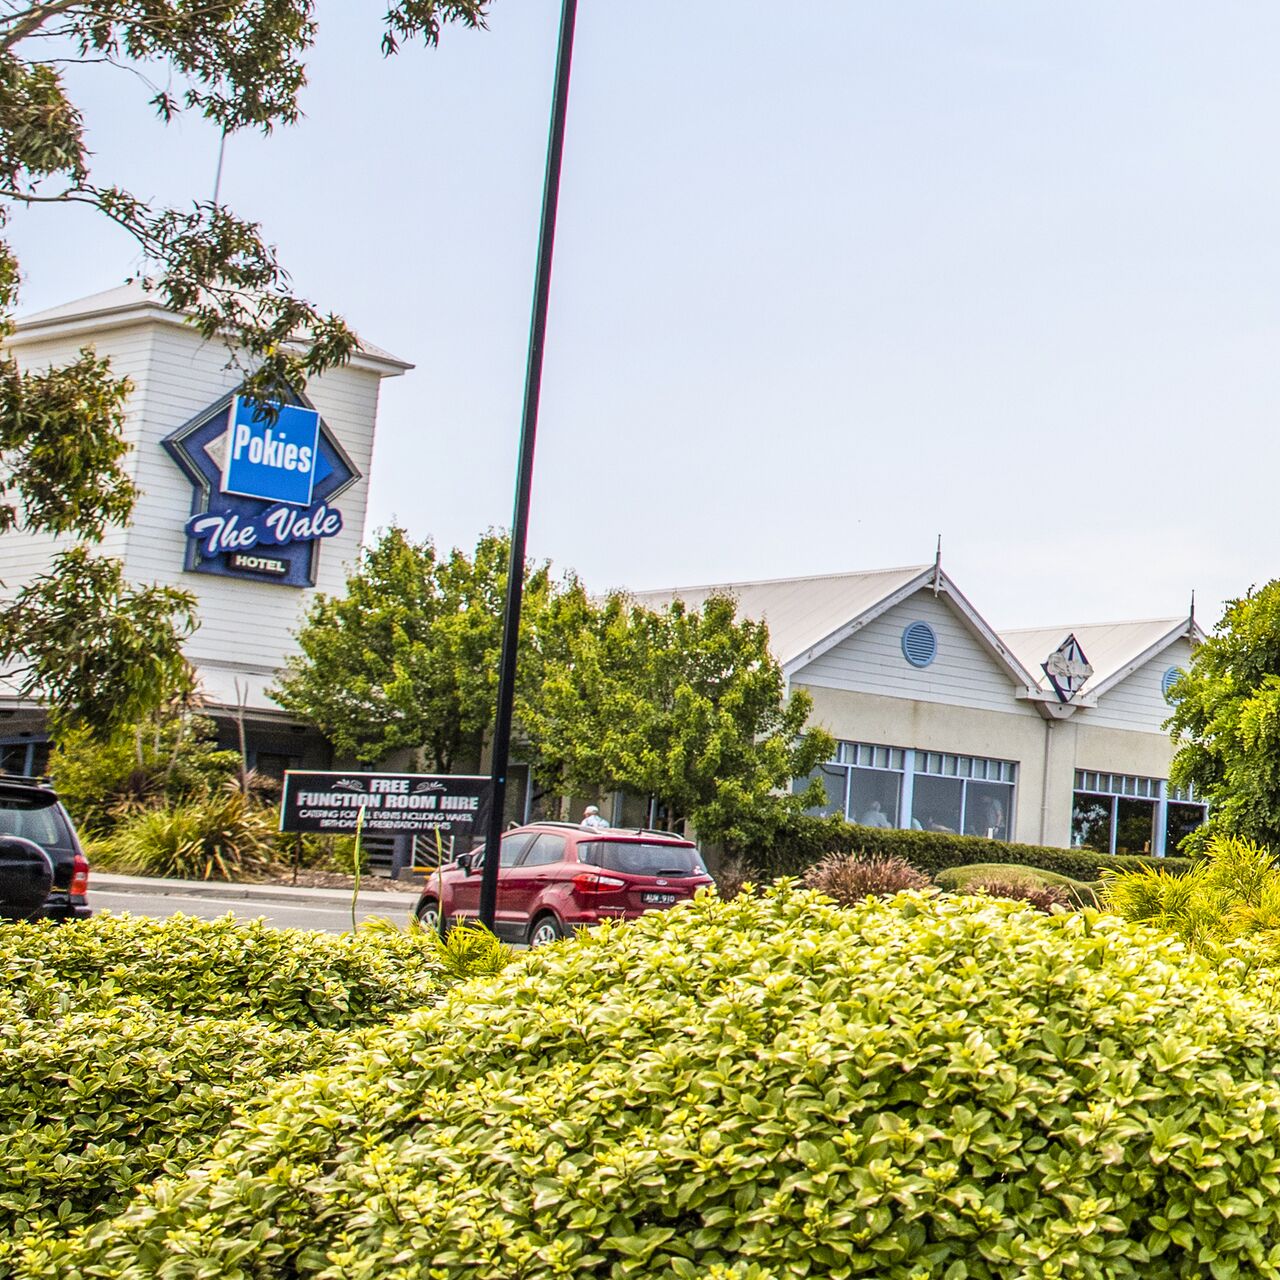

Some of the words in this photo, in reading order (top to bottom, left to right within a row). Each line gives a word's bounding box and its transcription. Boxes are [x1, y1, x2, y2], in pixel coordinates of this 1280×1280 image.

[233, 424, 312, 473] Pokies
[194, 515, 256, 552] The
[266, 505, 340, 542] Vale
[235, 555, 285, 572] HOTEL
[370, 779, 409, 793] FREE
[297, 793, 381, 808] FUNCTION
[384, 794, 436, 808] ROOM
[440, 797, 479, 810] HIRE
